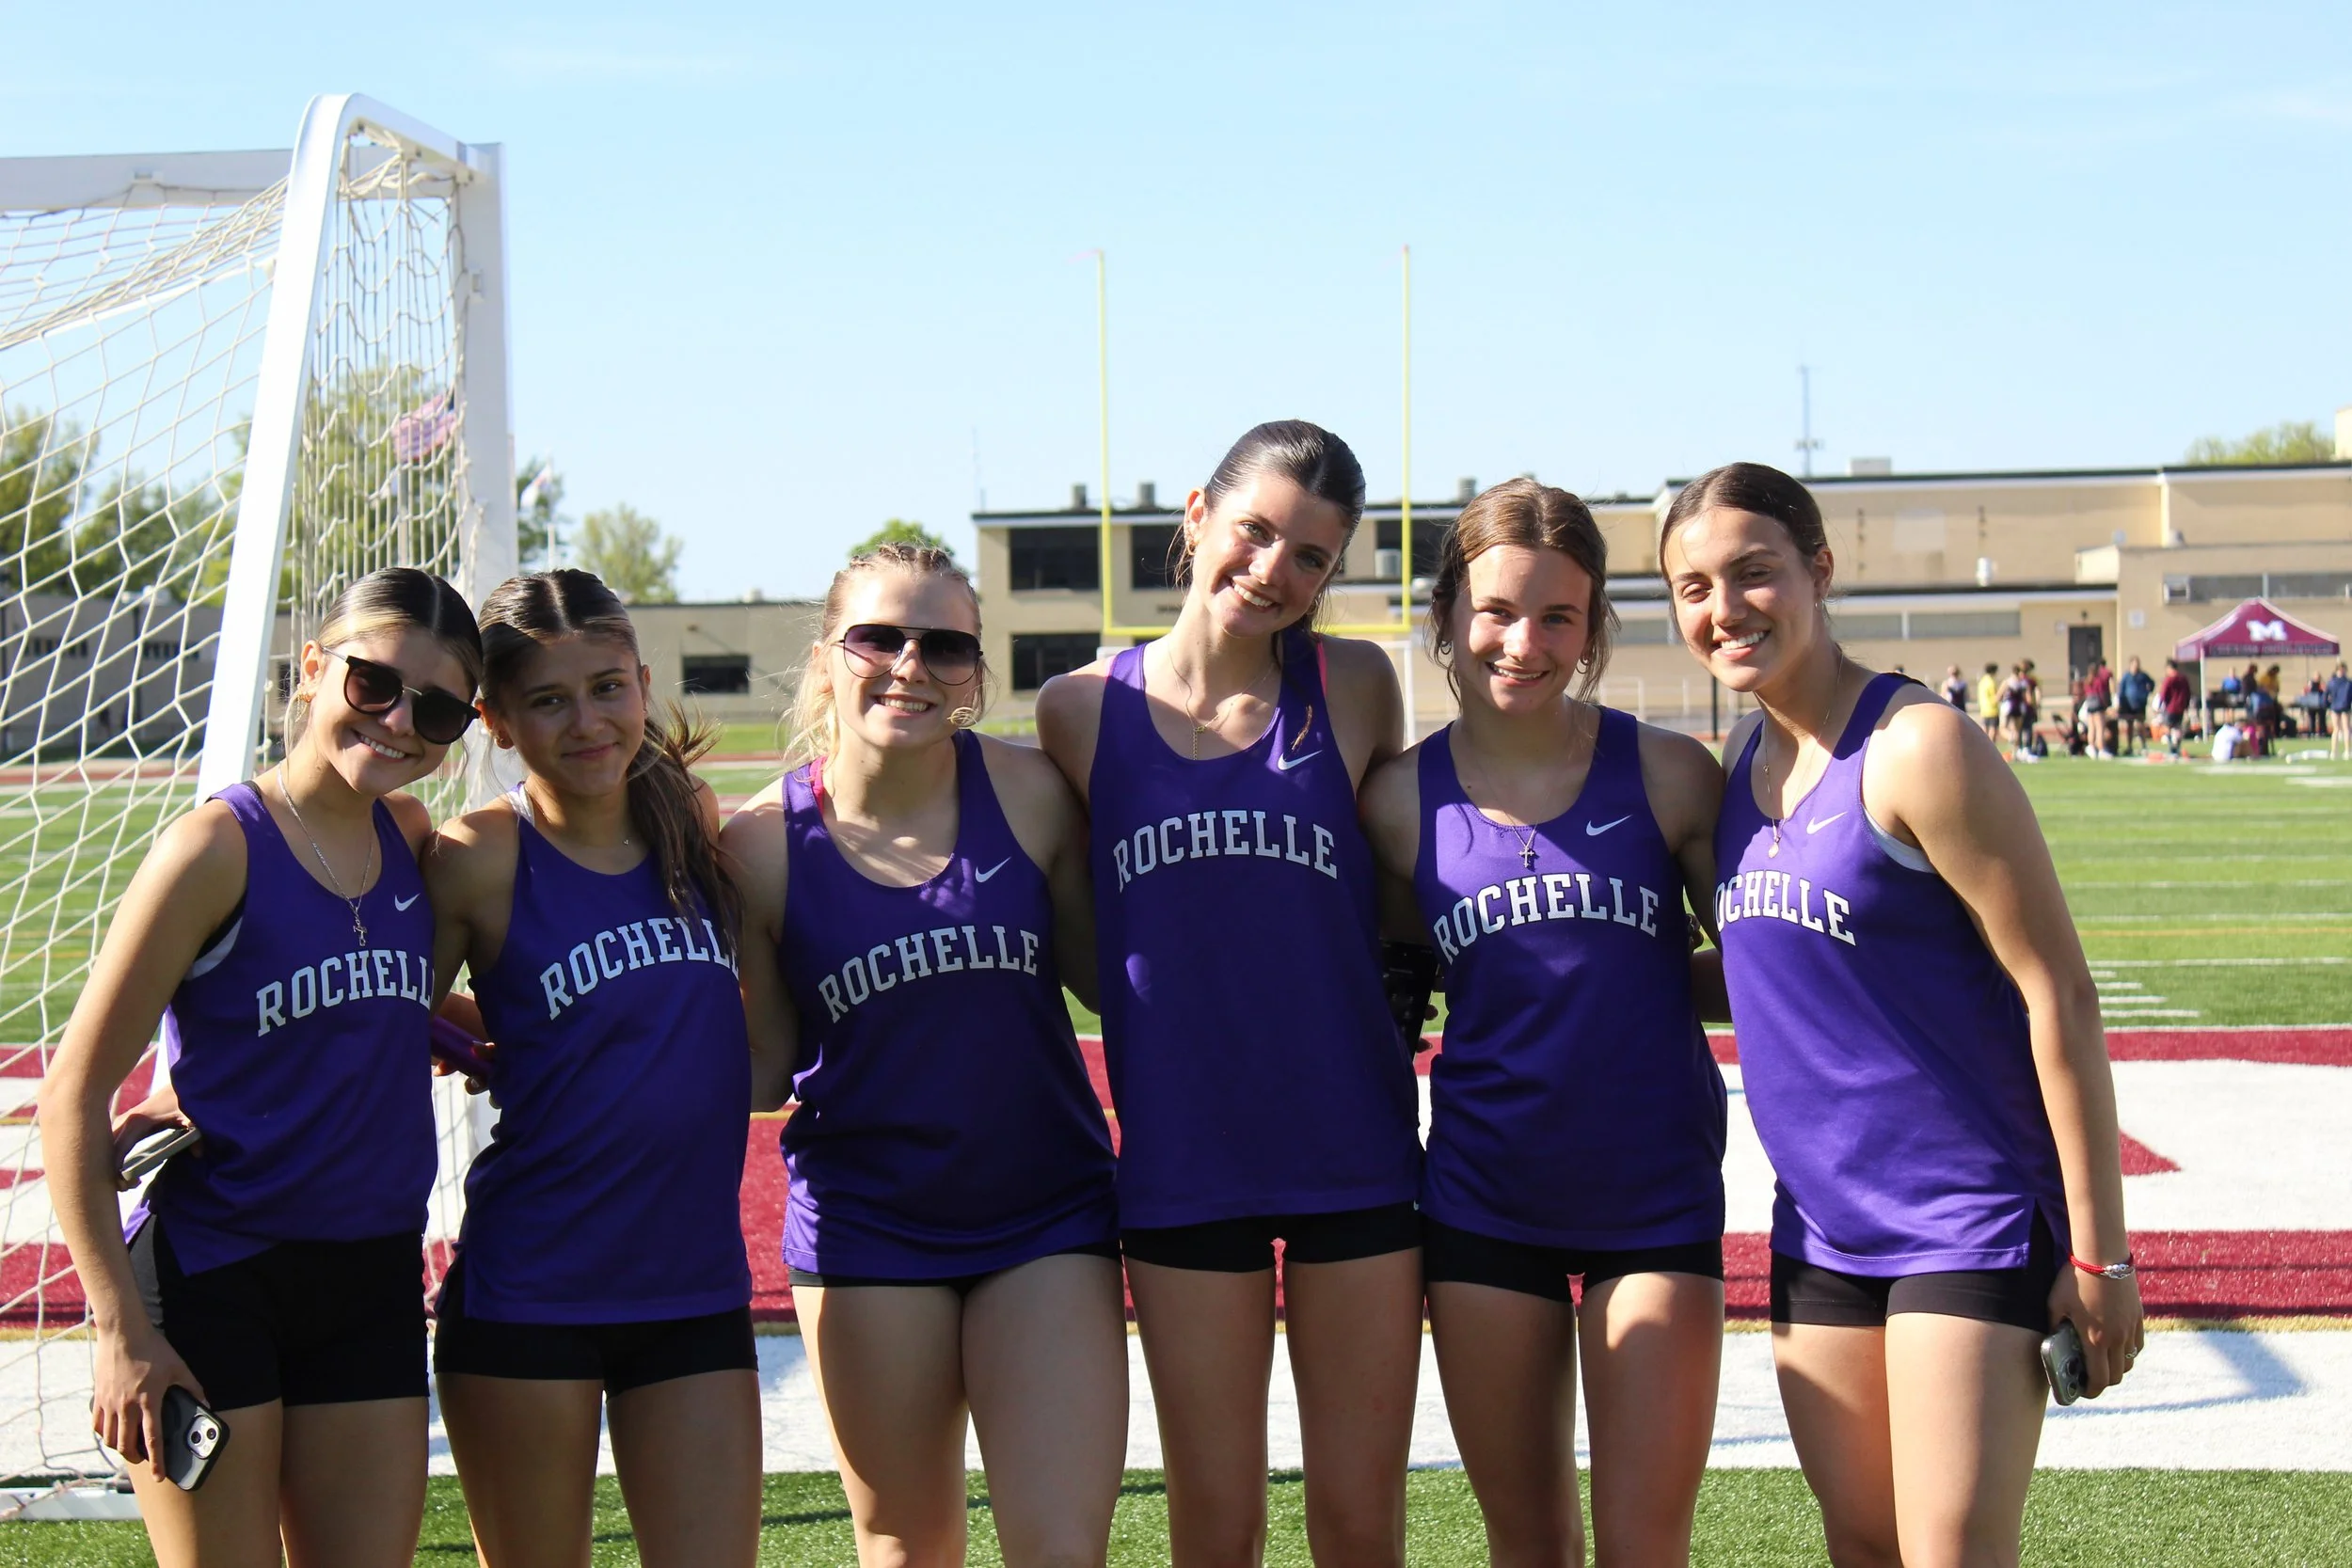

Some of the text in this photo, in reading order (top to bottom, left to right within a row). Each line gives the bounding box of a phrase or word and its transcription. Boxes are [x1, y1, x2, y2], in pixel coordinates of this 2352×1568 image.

[2246, 620, 2287, 641] M
[1113, 810, 1338, 894] ROCHELLE
[1433, 873, 1659, 965] ROCHELLE
[1713, 870, 1856, 946] OCHELLE
[256, 949, 435, 1037] ROCHELL
[818, 926, 1039, 1023] ROCHELLE
